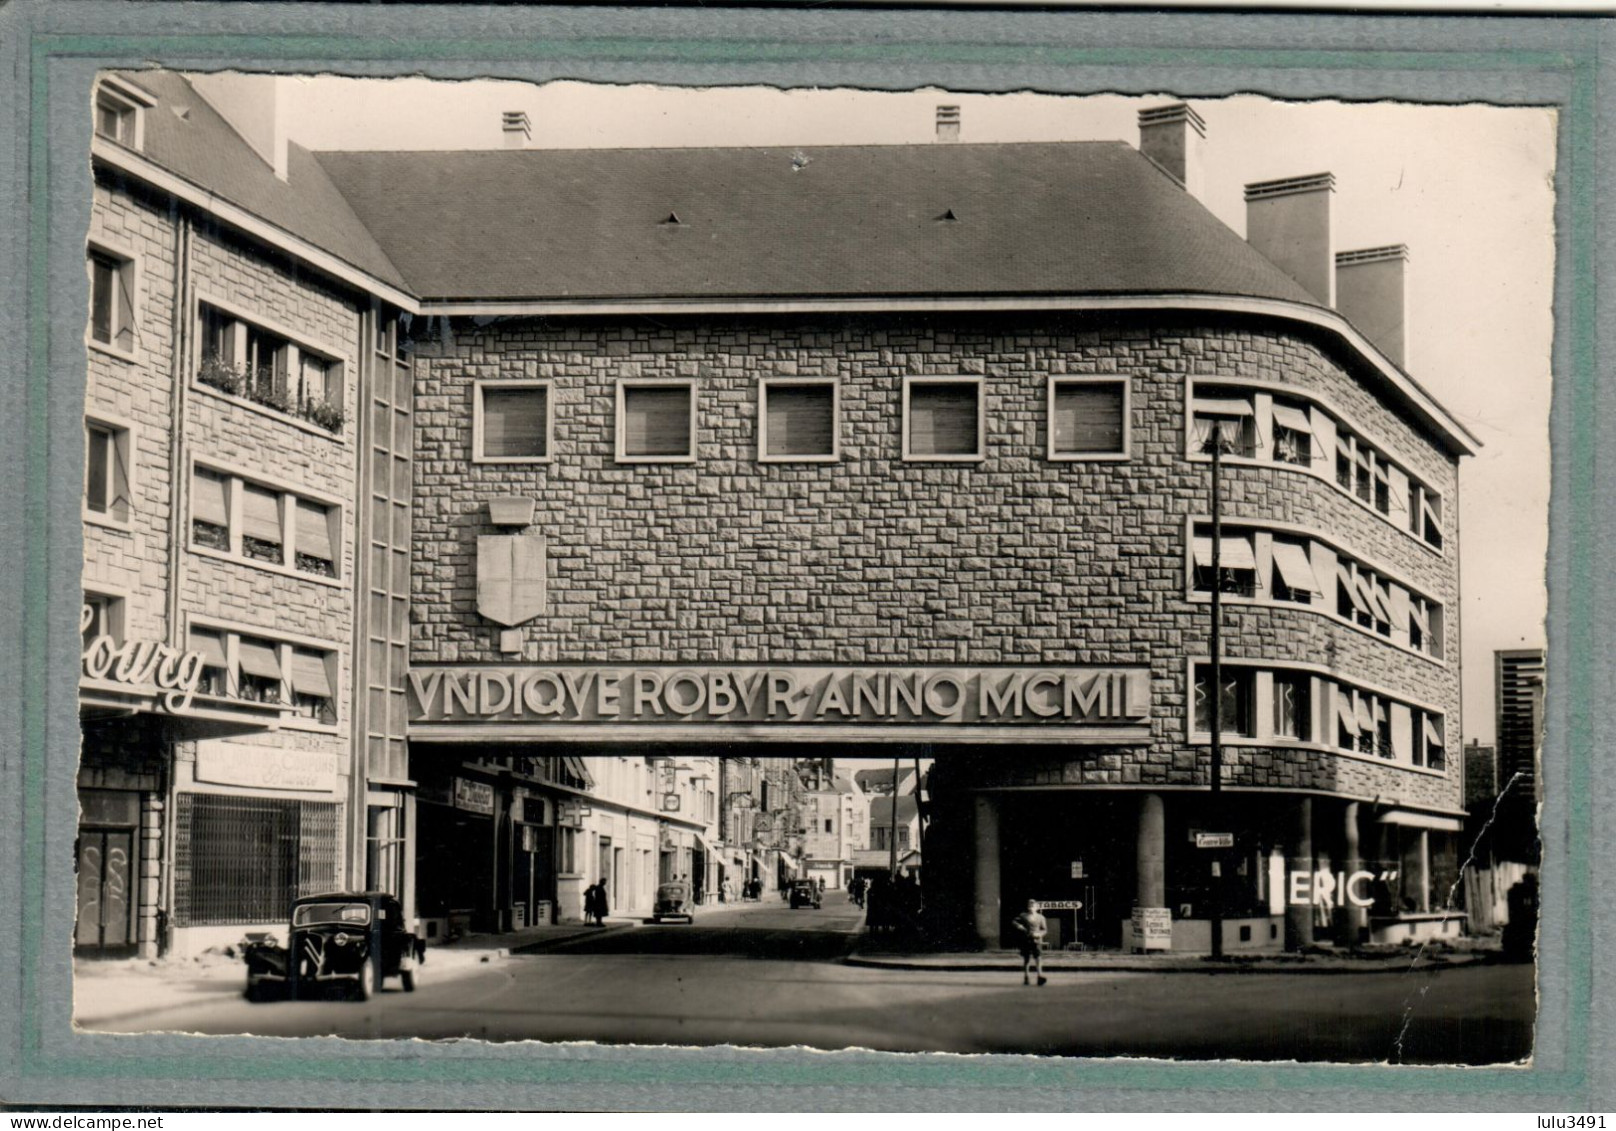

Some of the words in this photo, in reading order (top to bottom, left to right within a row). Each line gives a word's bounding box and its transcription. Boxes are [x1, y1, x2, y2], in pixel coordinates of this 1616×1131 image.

[408, 670, 622, 717] VNDIQVE
[815, 671, 968, 717] ANNO
[978, 671, 1150, 717] MCMIL
